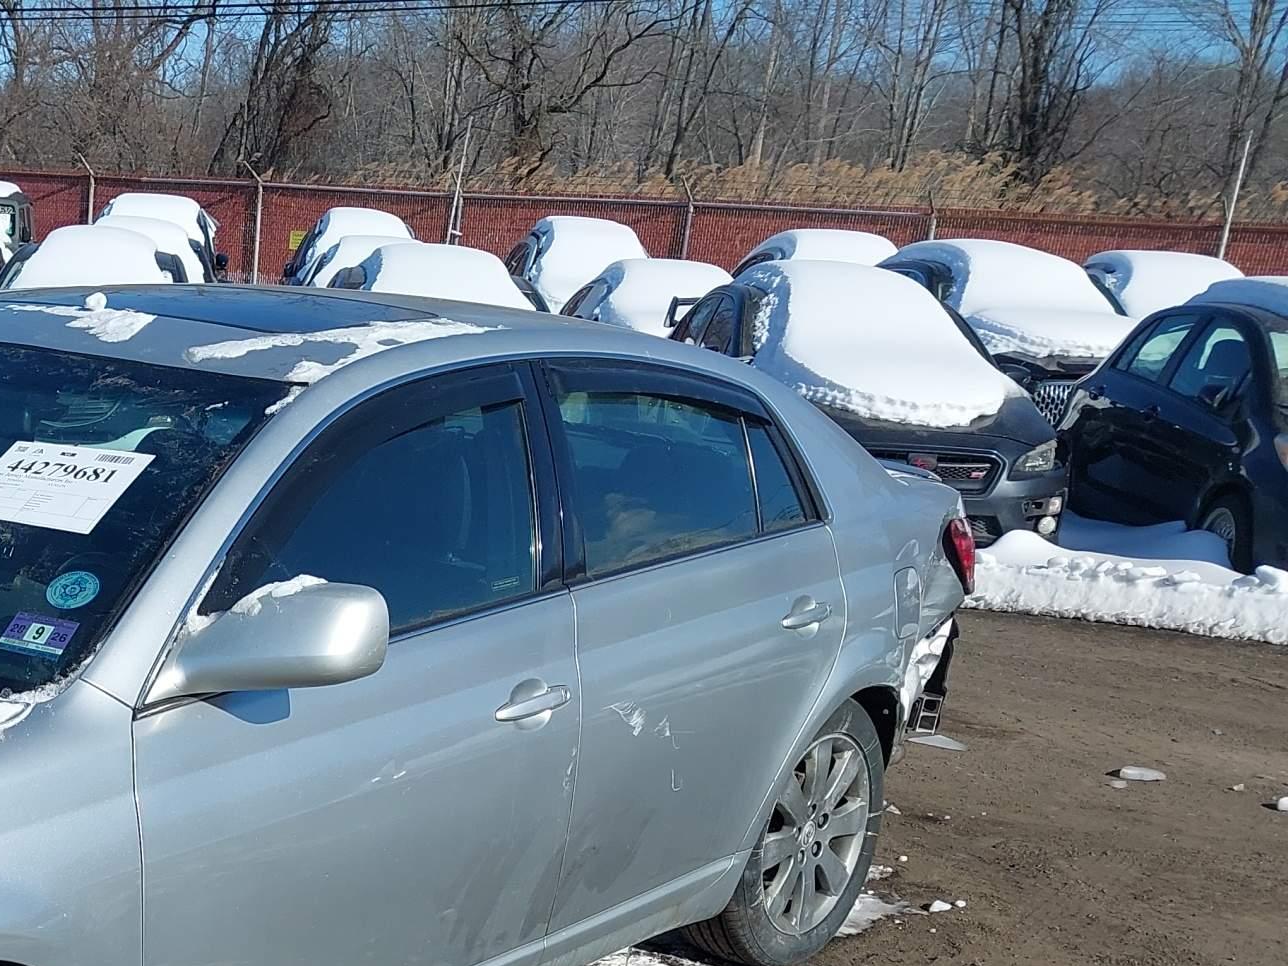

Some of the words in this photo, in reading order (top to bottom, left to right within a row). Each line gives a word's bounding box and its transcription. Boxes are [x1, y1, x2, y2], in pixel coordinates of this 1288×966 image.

[7, 458, 118, 483] 44279681
[10, 623, 26, 634] 20
[32, 626, 46, 641] 9
[51, 632, 68, 643] 26
